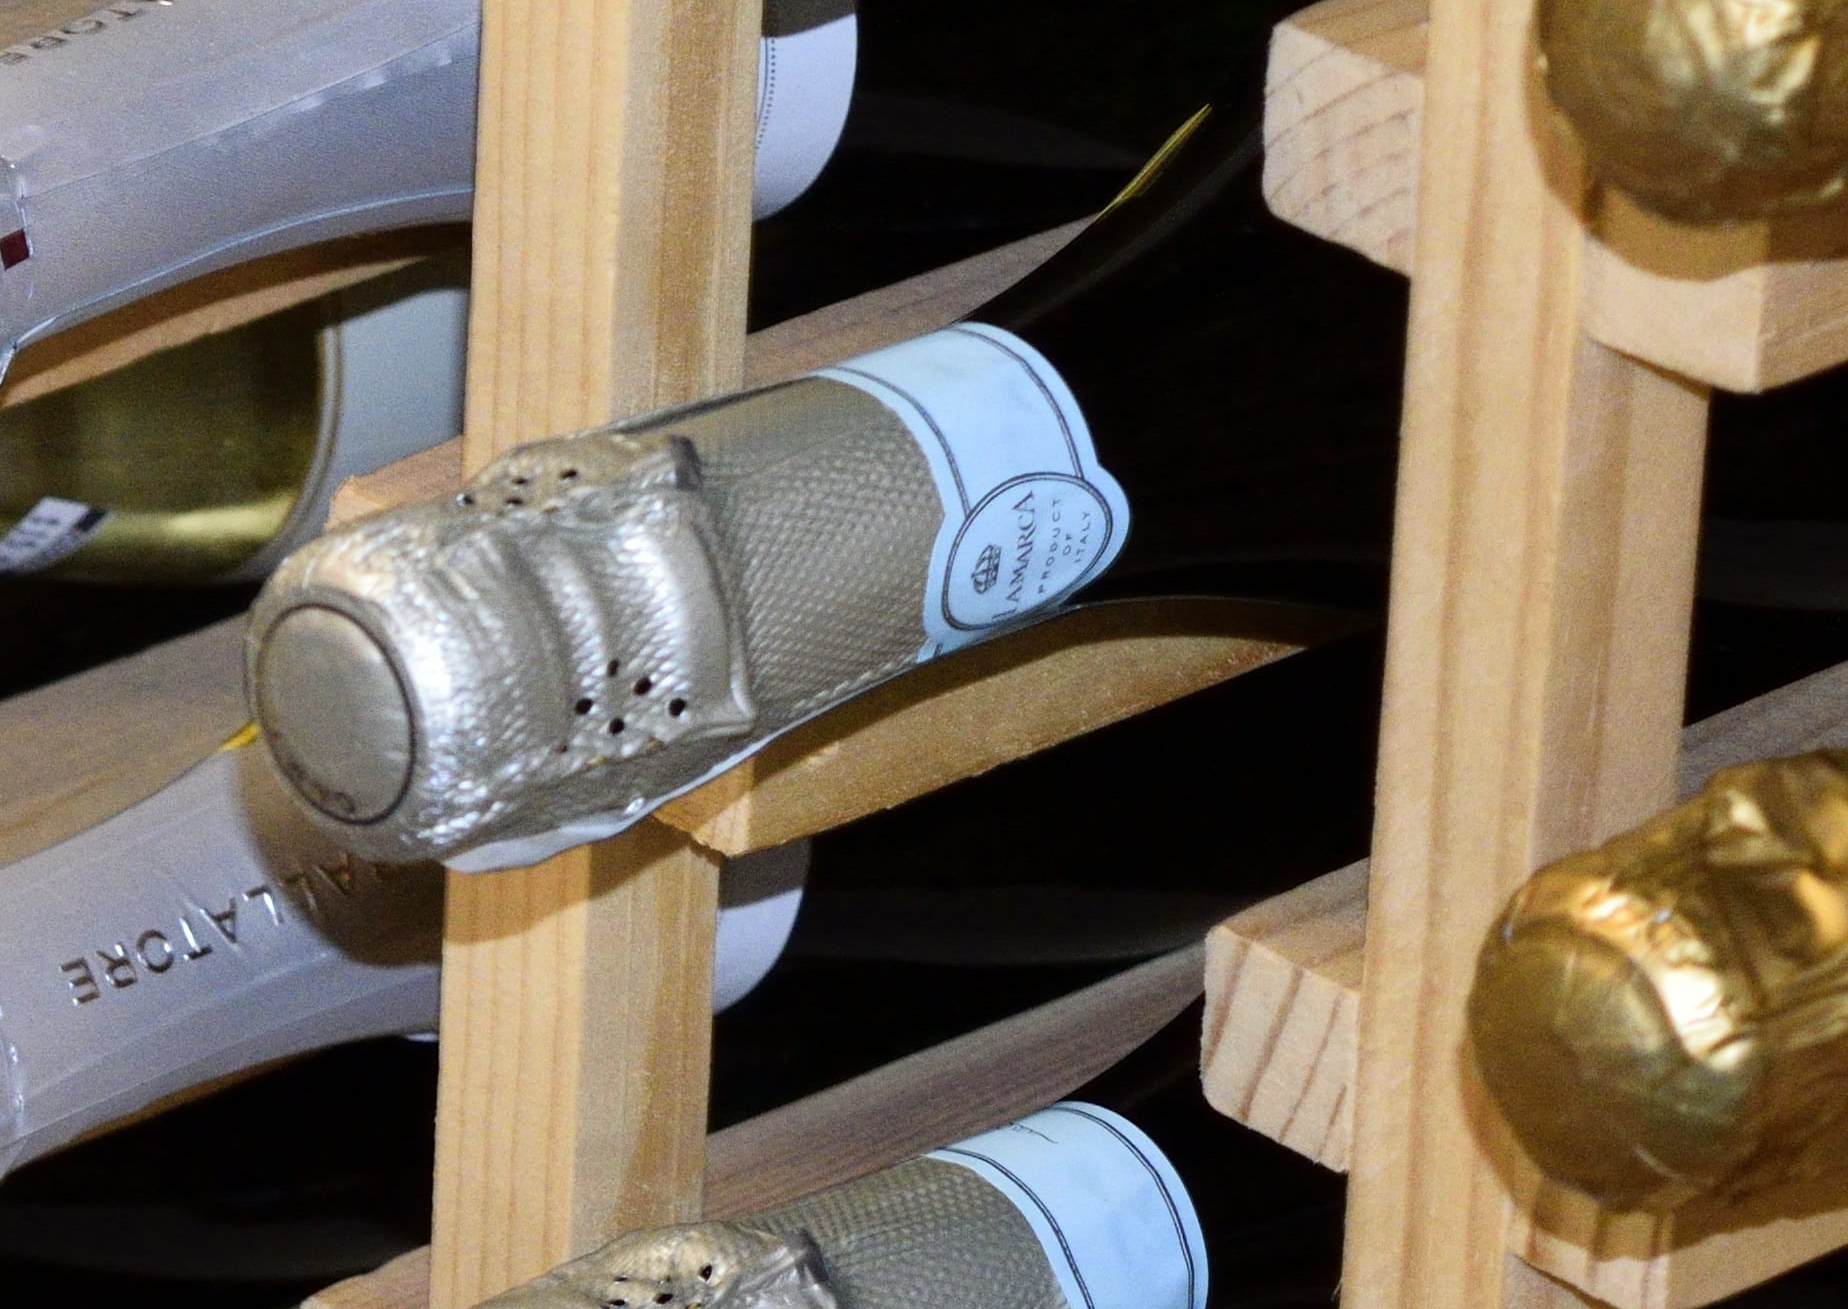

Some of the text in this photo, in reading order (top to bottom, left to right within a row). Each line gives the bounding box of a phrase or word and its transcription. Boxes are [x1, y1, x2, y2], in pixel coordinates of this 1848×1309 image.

[1038, 499, 1062, 594] PRODUCT
[1062, 533, 1073, 557] OF
[1073, 511, 1091, 564] ITALY
